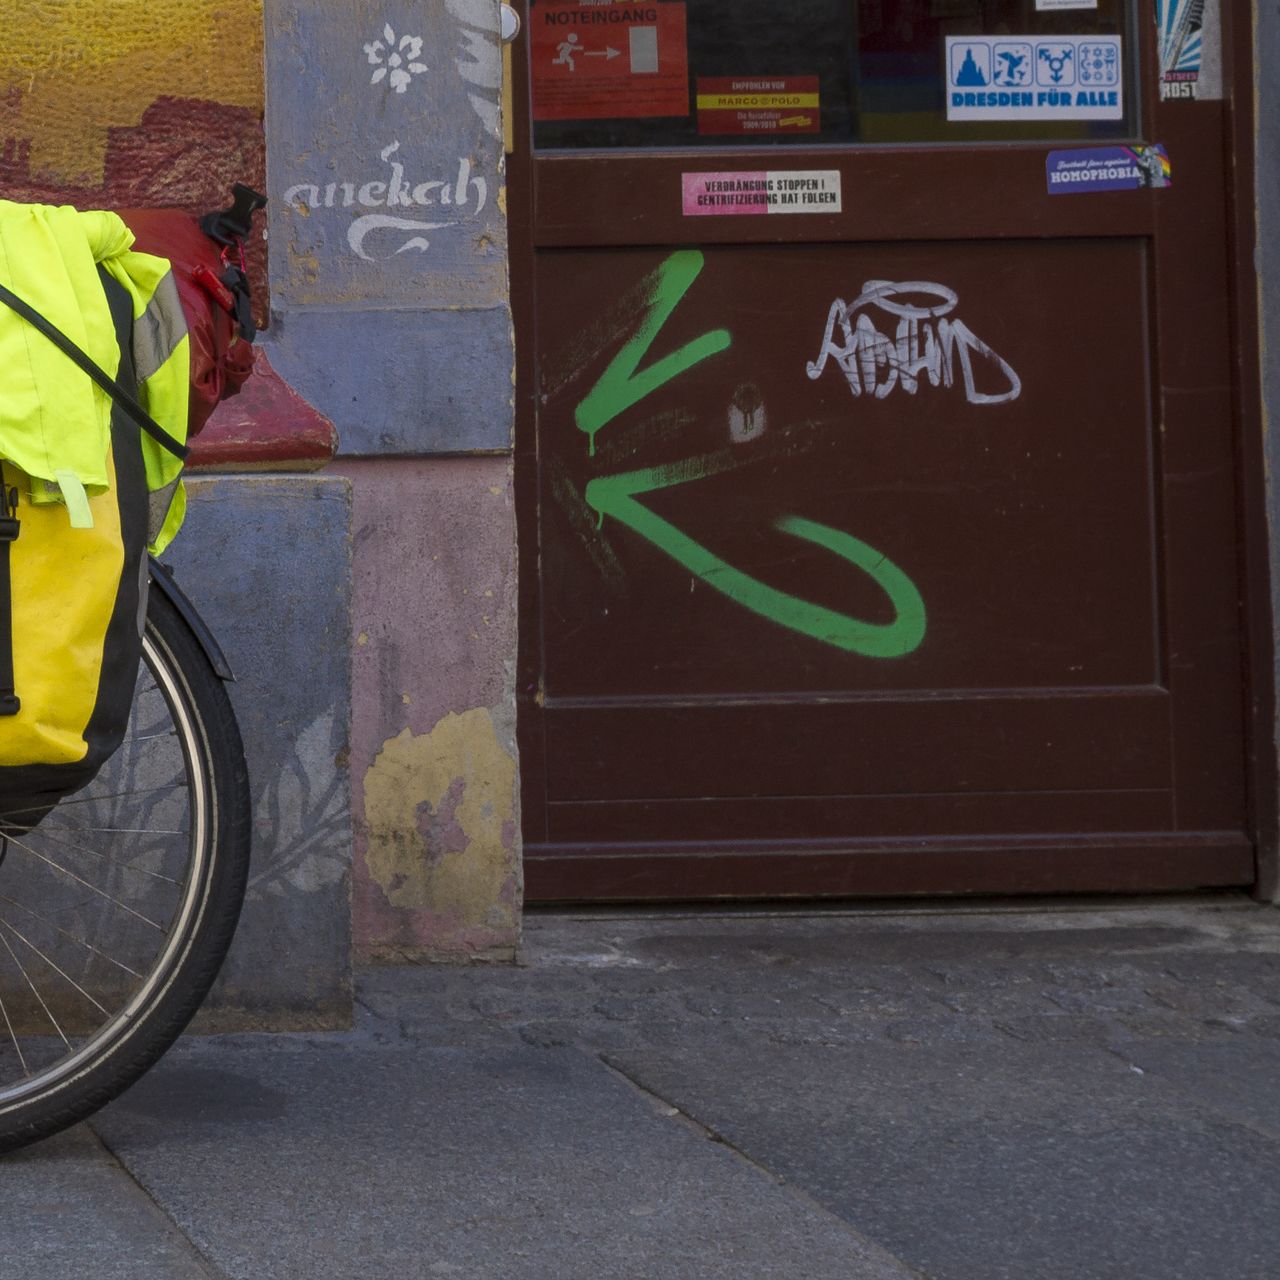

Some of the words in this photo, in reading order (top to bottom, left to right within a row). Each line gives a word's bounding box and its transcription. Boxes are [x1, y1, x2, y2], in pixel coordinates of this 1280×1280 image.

[544, 8, 657, 26] NOTEINGANG
[718, 97, 759, 105] MARCO
[771, 96, 801, 105] POLO
[951, 91, 1034, 108] DRESDEN
[1037, 88, 1072, 107] FÜR
[1075, 91, 1118, 107] ALLE
[1050, 166, 1142, 183] HOMOPHOBIA
[704, 178, 774, 193] VERDRÄNGUNG
[777, 179, 819, 191] STOPPEN
[781, 193, 799, 204] HAT
[802, 192, 837, 204] FOLGEN
